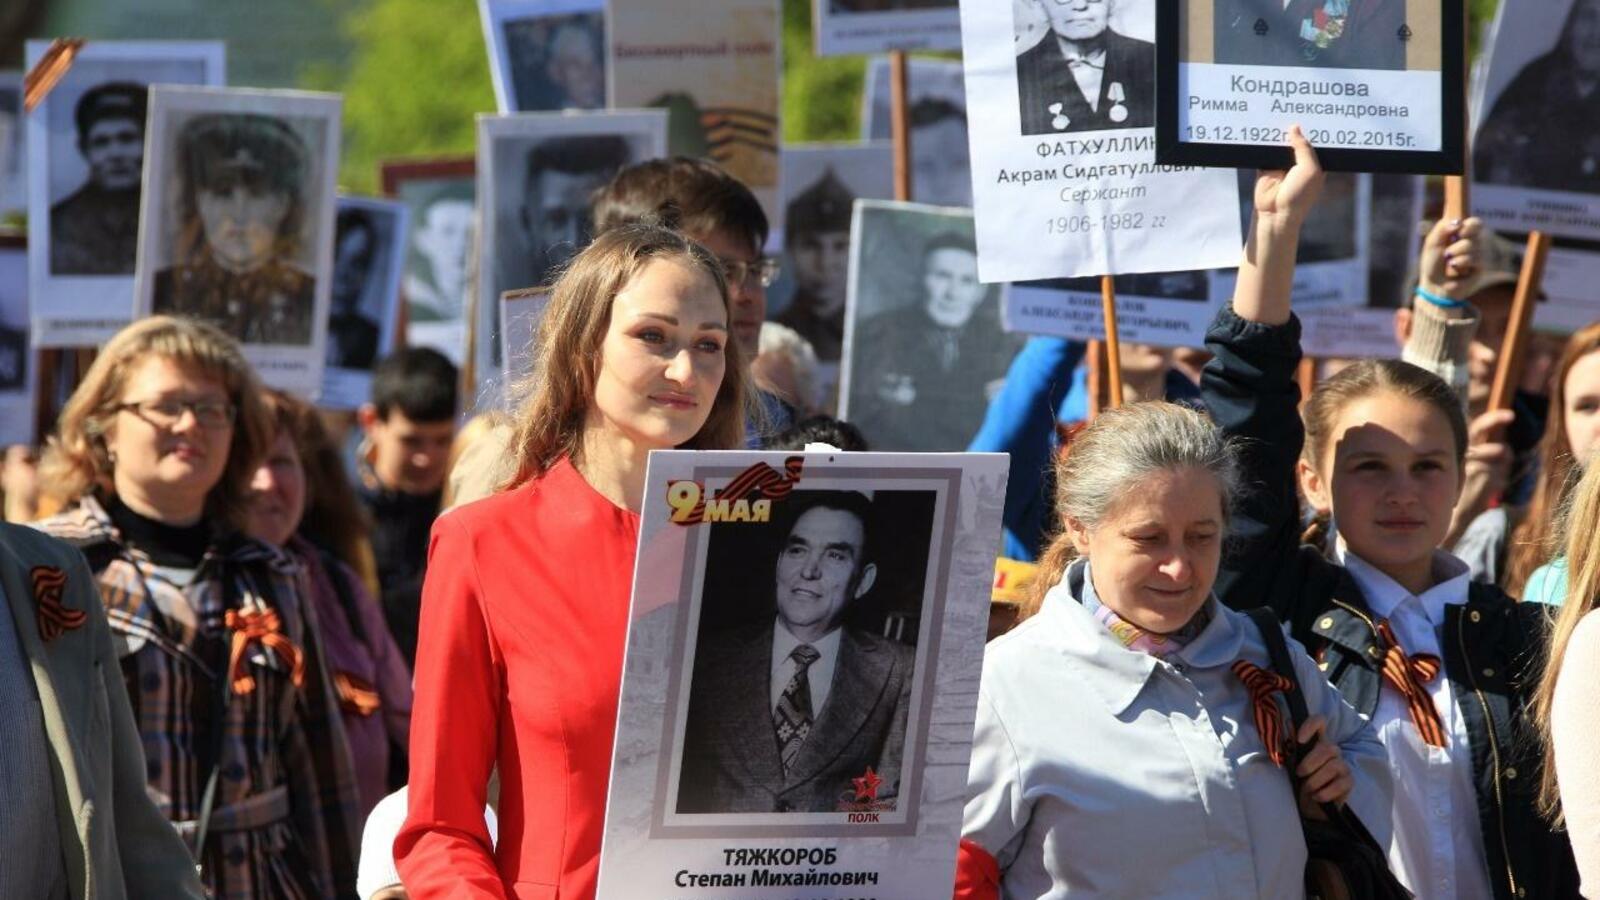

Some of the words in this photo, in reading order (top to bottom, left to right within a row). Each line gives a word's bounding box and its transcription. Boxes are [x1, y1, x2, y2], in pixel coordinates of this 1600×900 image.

[1231, 74, 1370, 97] Кондрашова
[1189, 95, 1249, 112] Римма
[1270, 98, 1410, 118] Александровна
[1310, 129, 1416, 147] 20.02.2015г.
[997, 167, 1057, 185] Акрам
[1063, 163, 1207, 179] Сидгатуллови
[1060, 185, 1147, 205] Сержант
[1046, 213, 1144, 235] 1906-1982
[666, 480, 700, 522] 9
[702, 499, 771, 522] МАЯ
[848, 813, 879, 823] ПОЛК
[723, 848, 837, 866] ТЯЖКОРОБ
[675, 870, 746, 887] Степан
[750, 868, 879, 887] Михайлович
